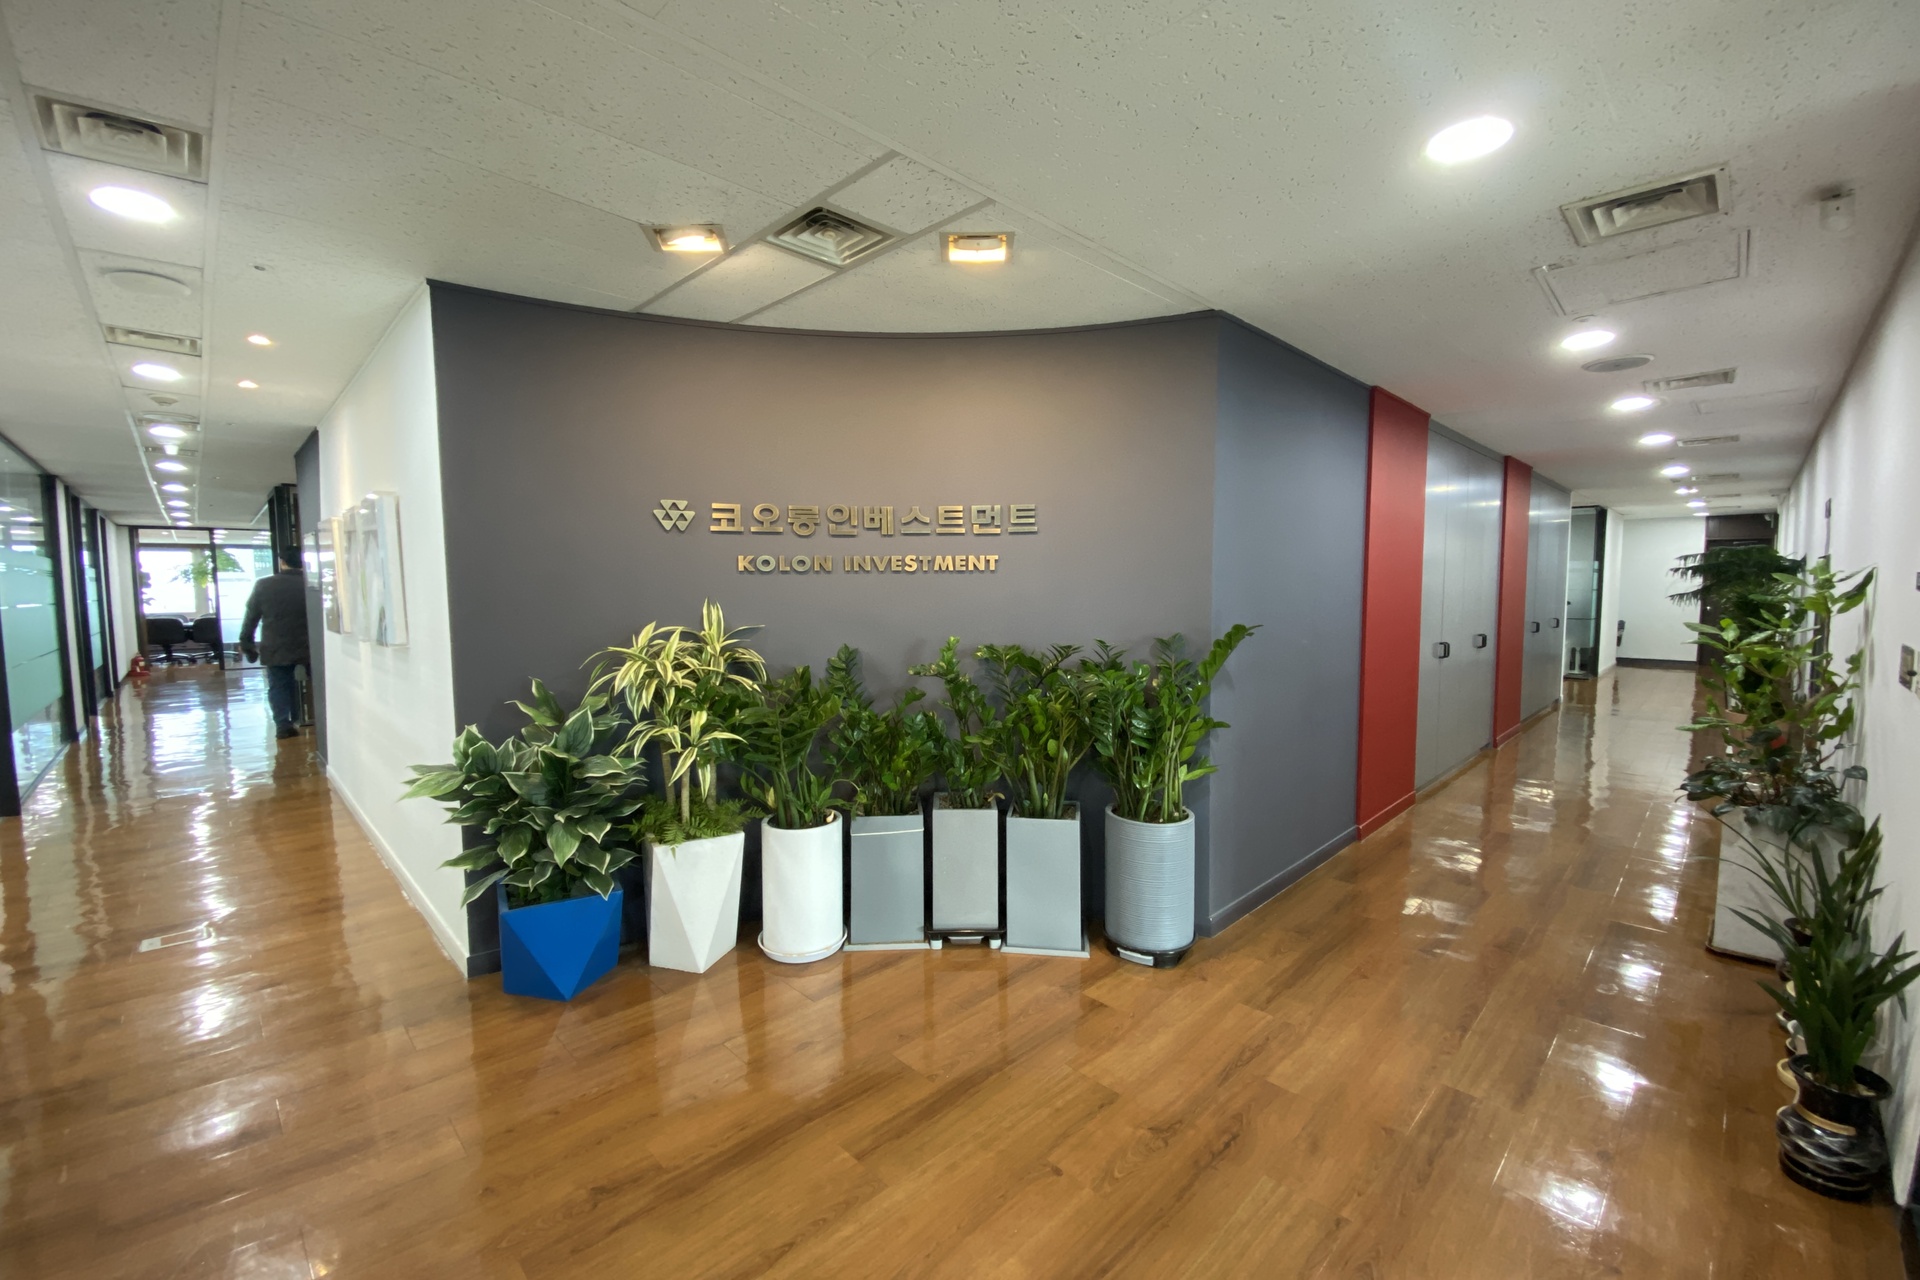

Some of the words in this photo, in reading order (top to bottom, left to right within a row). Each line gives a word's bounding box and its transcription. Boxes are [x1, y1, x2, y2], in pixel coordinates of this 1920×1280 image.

[710, 503, 1038, 536] 코오롱인베스트먼트
[737, 554, 832, 572] KOLON
[844, 554, 999, 572] INVESTMENT
